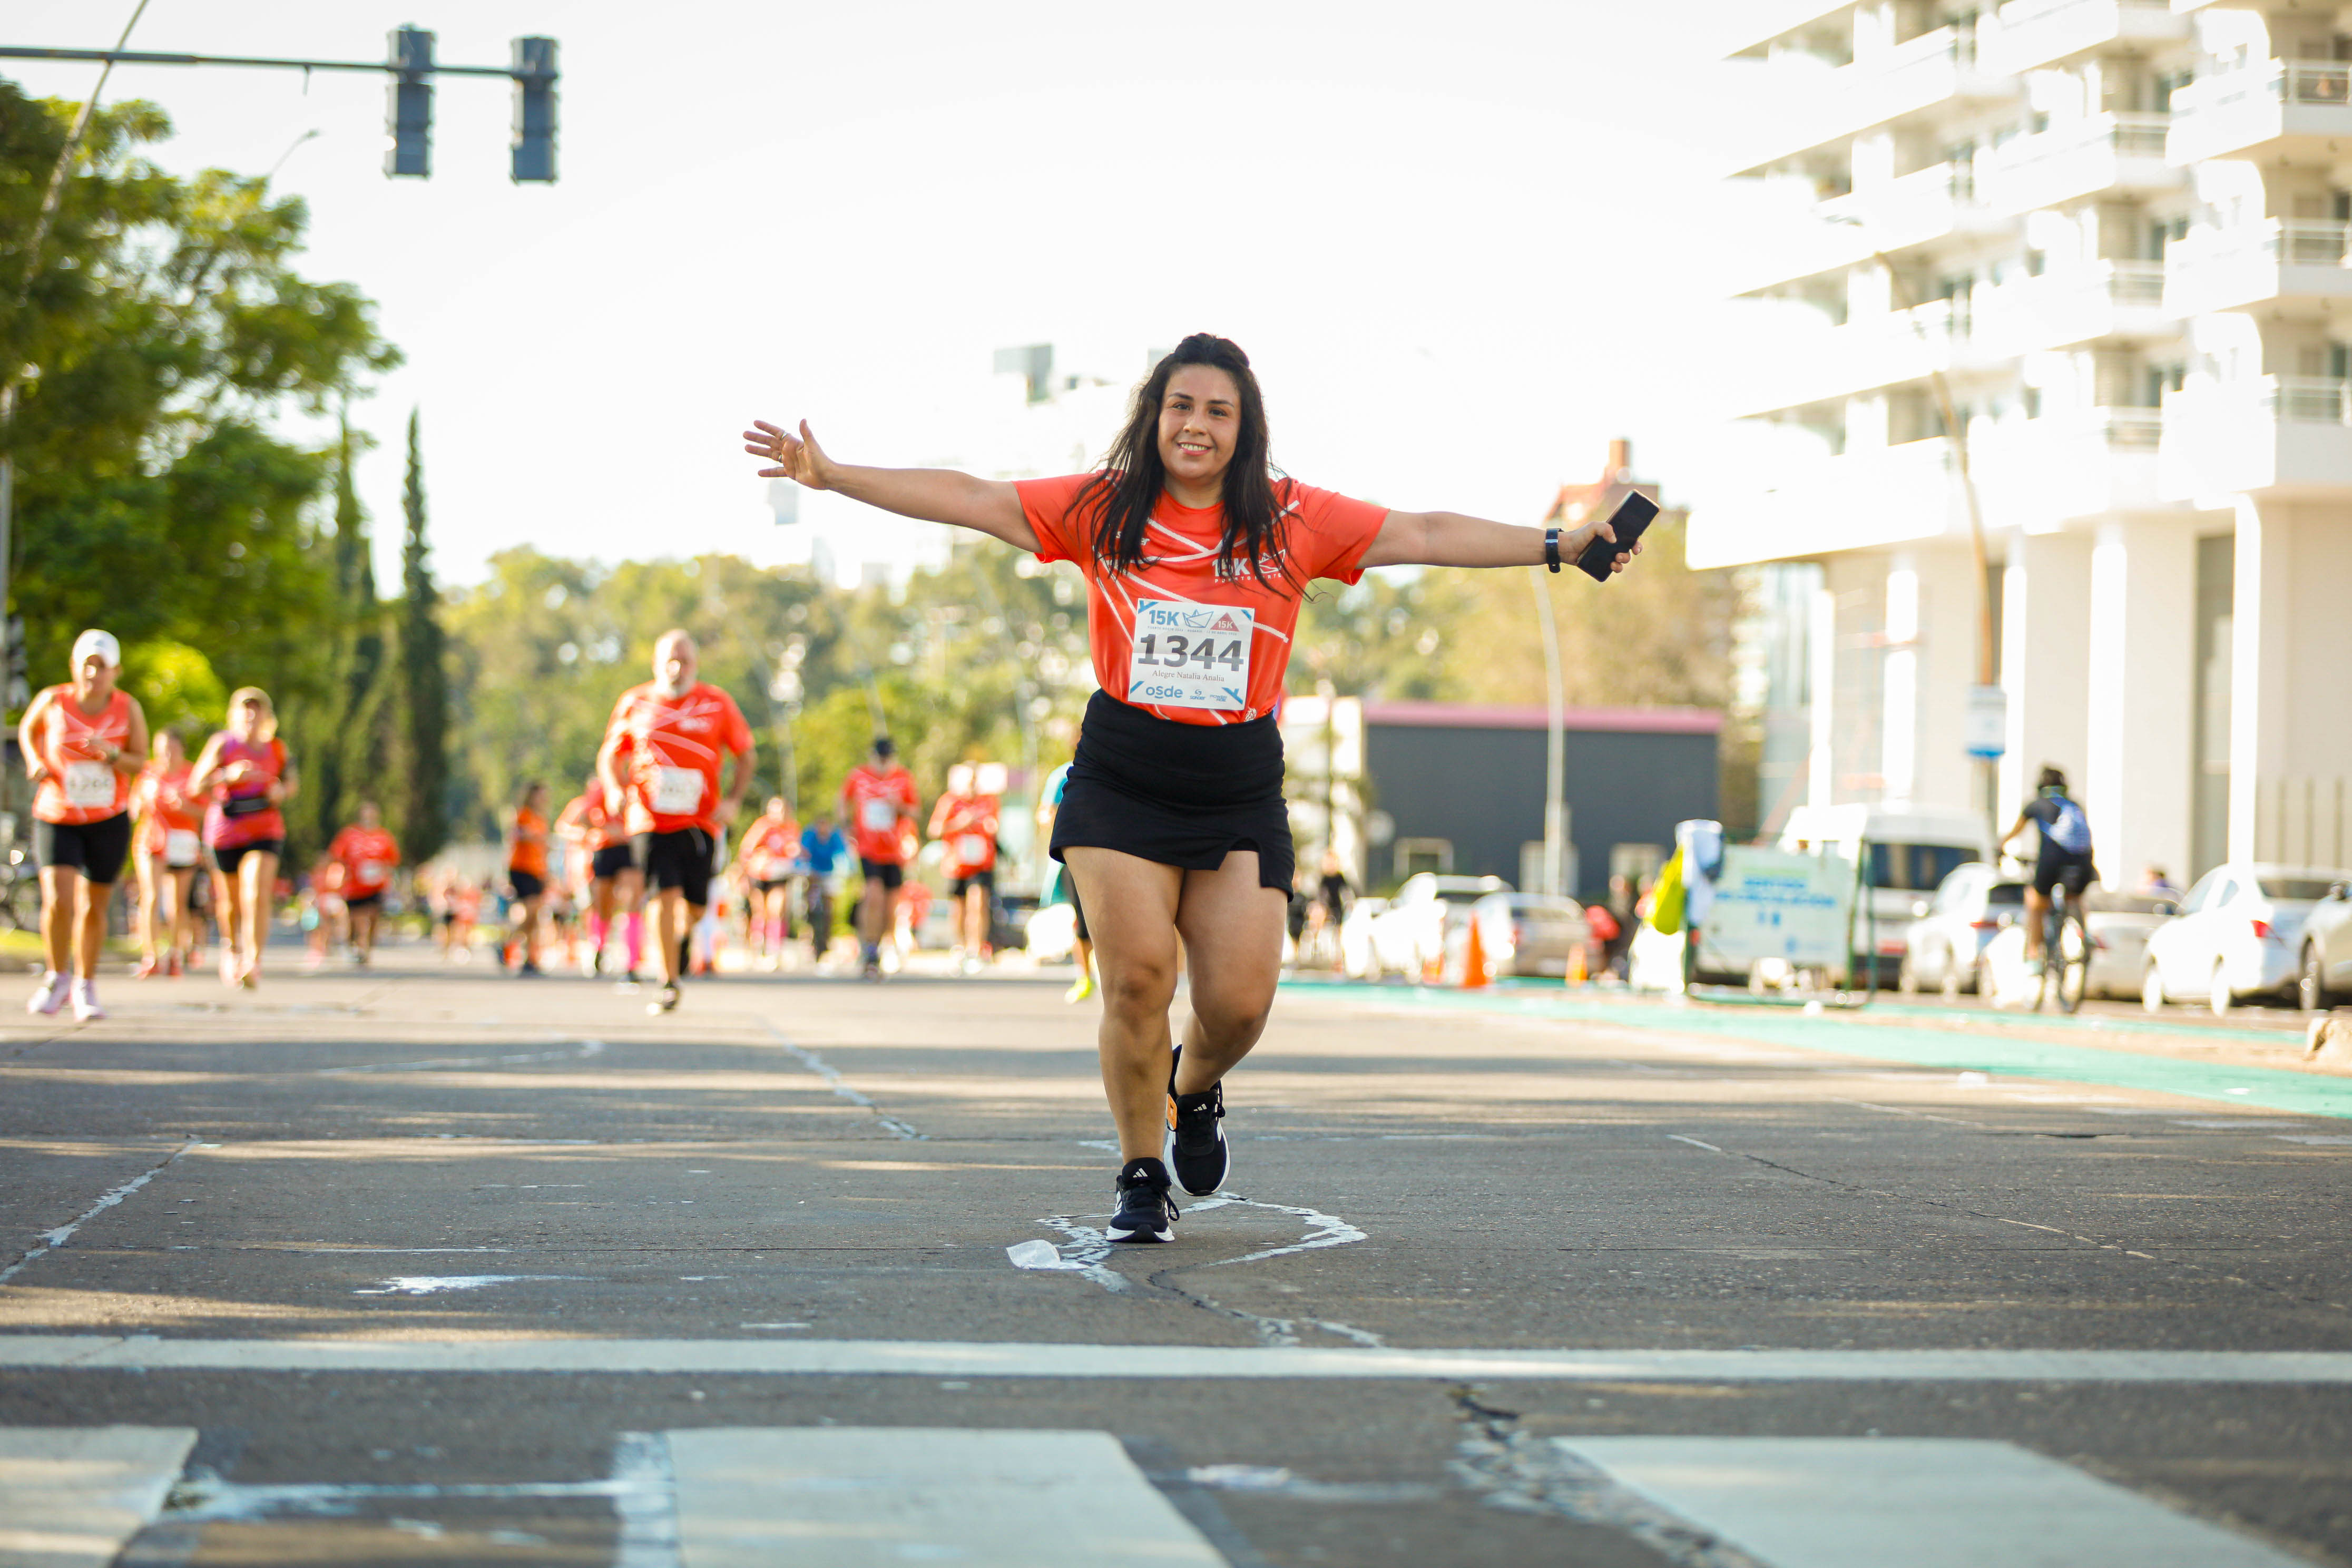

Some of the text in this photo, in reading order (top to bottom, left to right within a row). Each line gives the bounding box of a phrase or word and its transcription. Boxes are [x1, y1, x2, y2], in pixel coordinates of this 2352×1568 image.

[1149, 610, 1180, 626] 15K
[1218, 621, 1233, 629] 15K
[1138, 633, 1244, 672] 1344
[1152, 670, 1175, 679] Alegre
[1177, 671, 1200, 680] Natalia
[1146, 685, 1183, 699] osde
